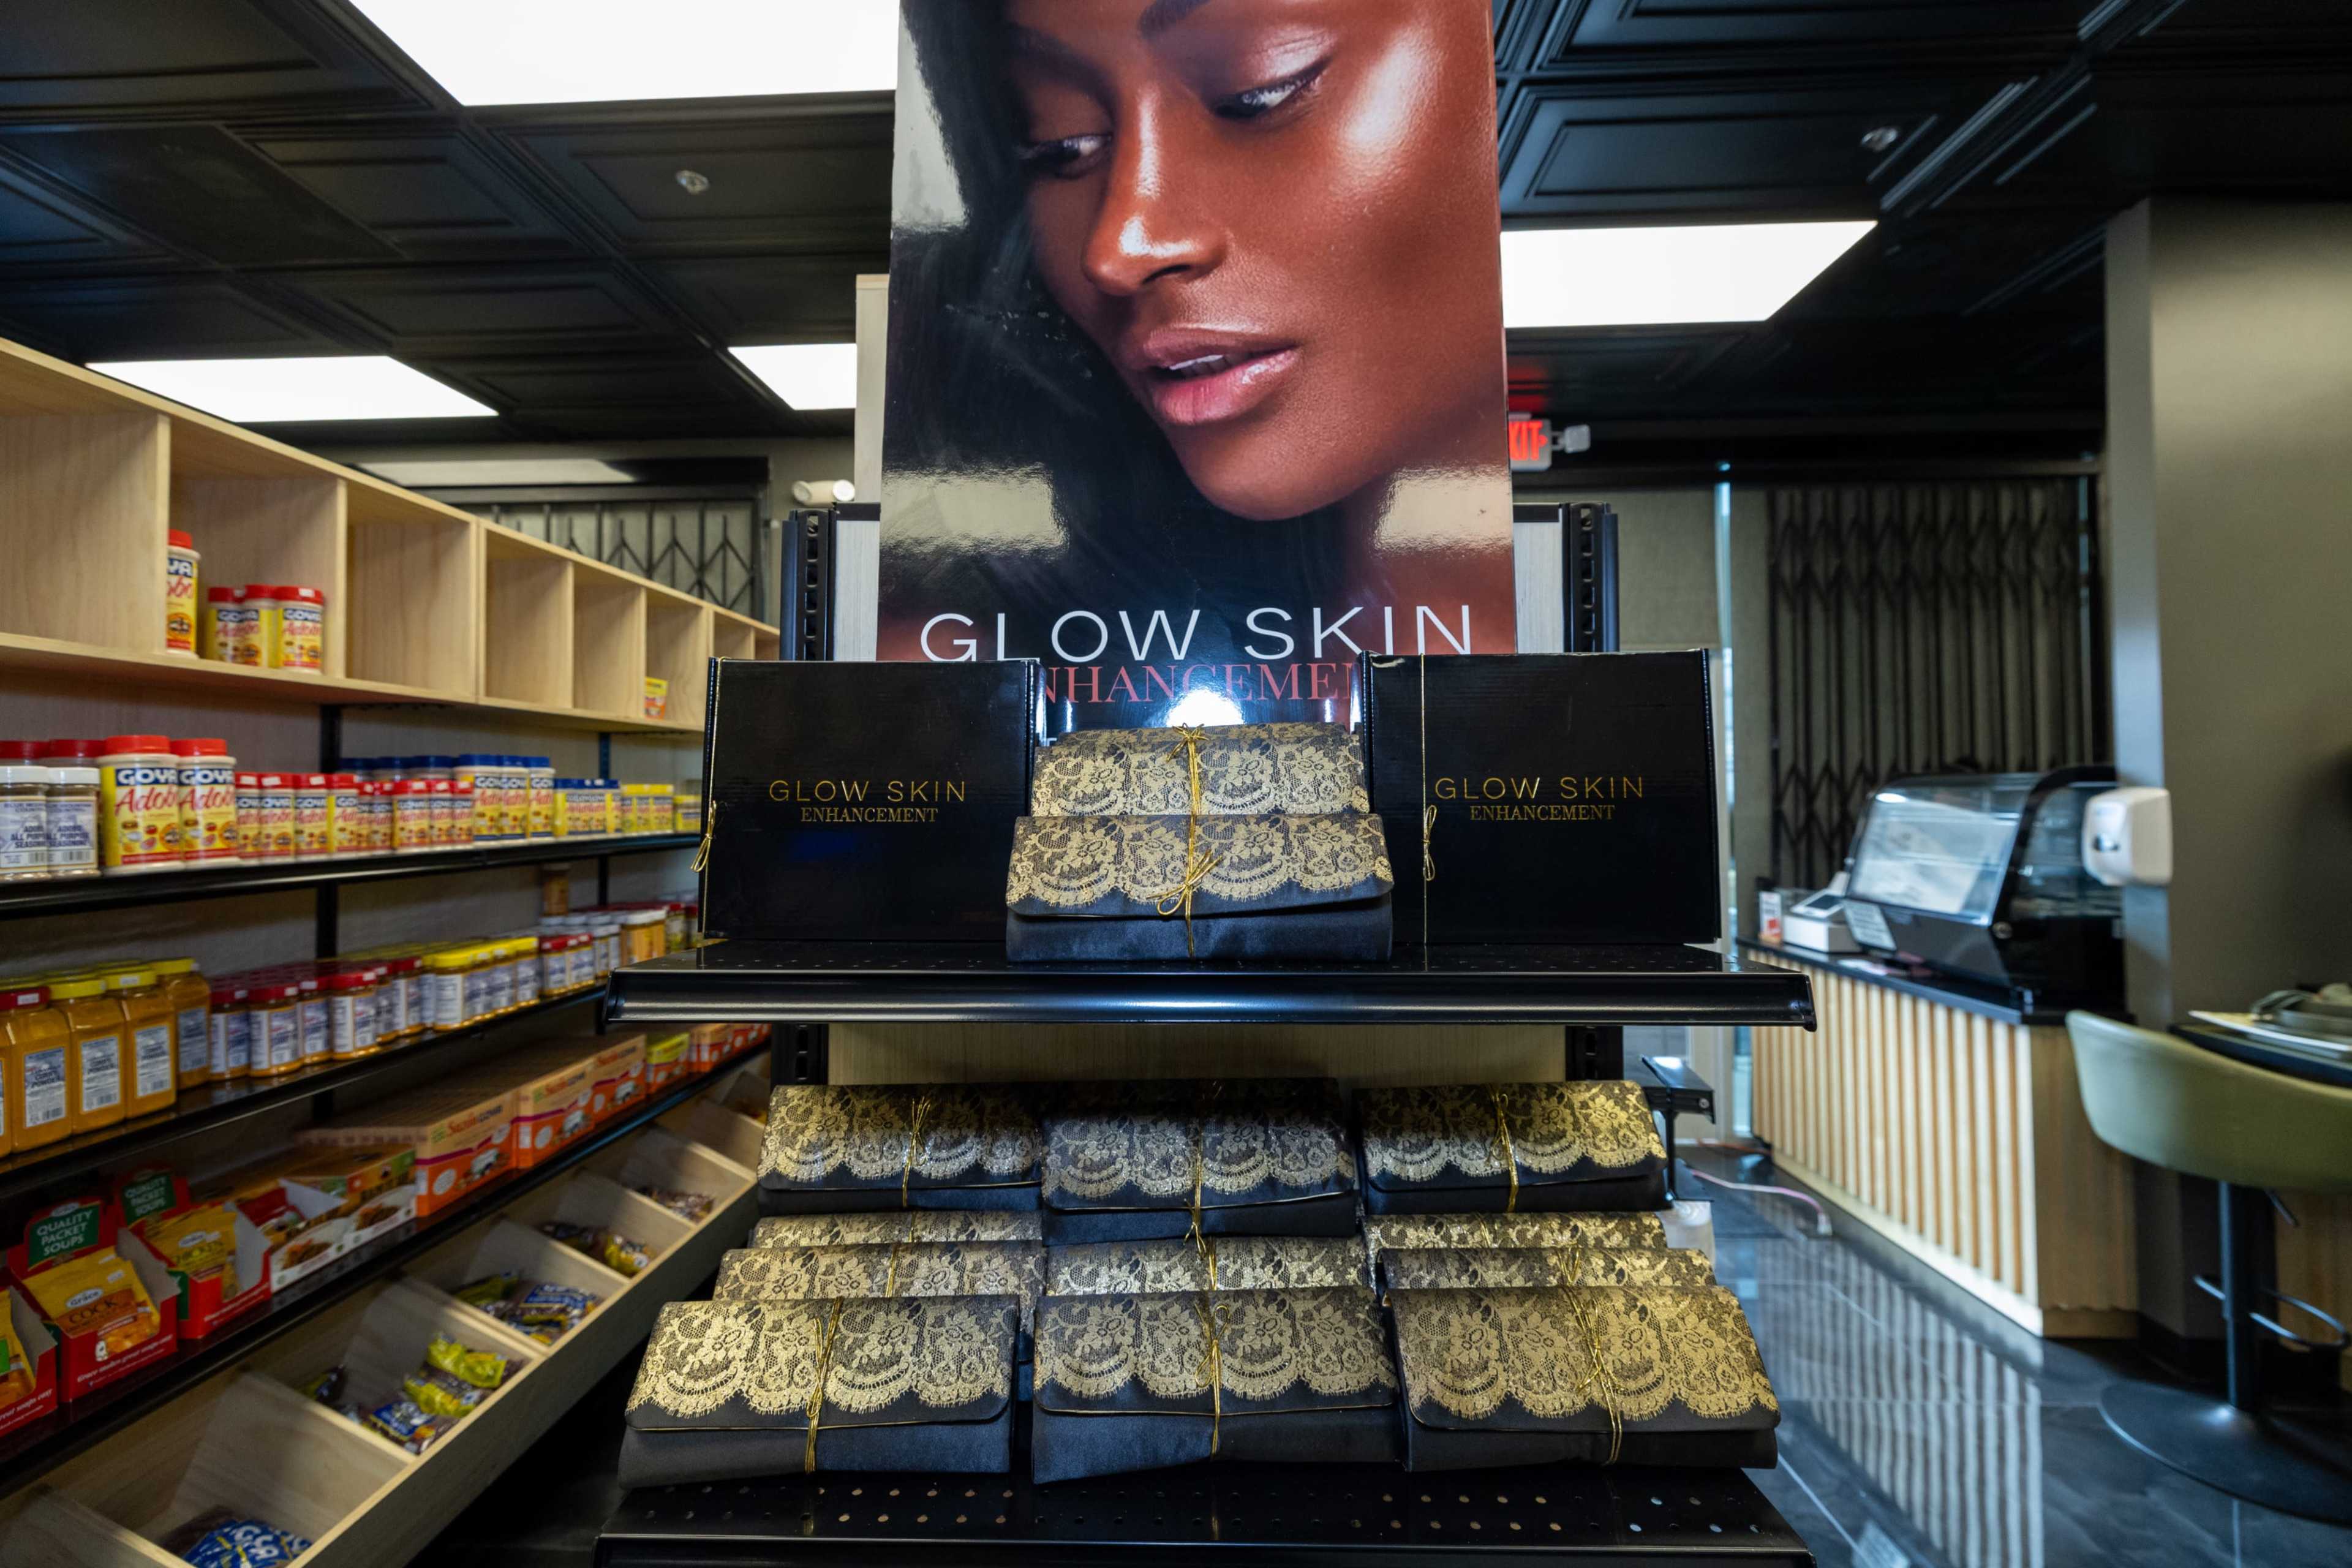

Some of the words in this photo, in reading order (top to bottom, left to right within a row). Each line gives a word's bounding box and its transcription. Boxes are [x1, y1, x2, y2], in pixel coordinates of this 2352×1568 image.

[1509, 421, 1542, 461] XIT
[167, 558, 194, 578] YA
[921, 609, 1200, 662] GLOW
[1244, 605, 1471, 660] SKIN
[769, 780, 869, 802] GLOW
[888, 780, 965, 802] SKIN
[1435, 777, 1540, 799] GLOW
[1560, 777, 1642, 799] SKIN
[801, 807, 938, 822] ENHANCEMENT
[1470, 805, 1615, 821] ENHANCEMENT
[36, 1210, 91, 1235] QUALITY
[40, 1223, 88, 1245] PACKET
[43, 1235, 84, 1256] SOUPS
